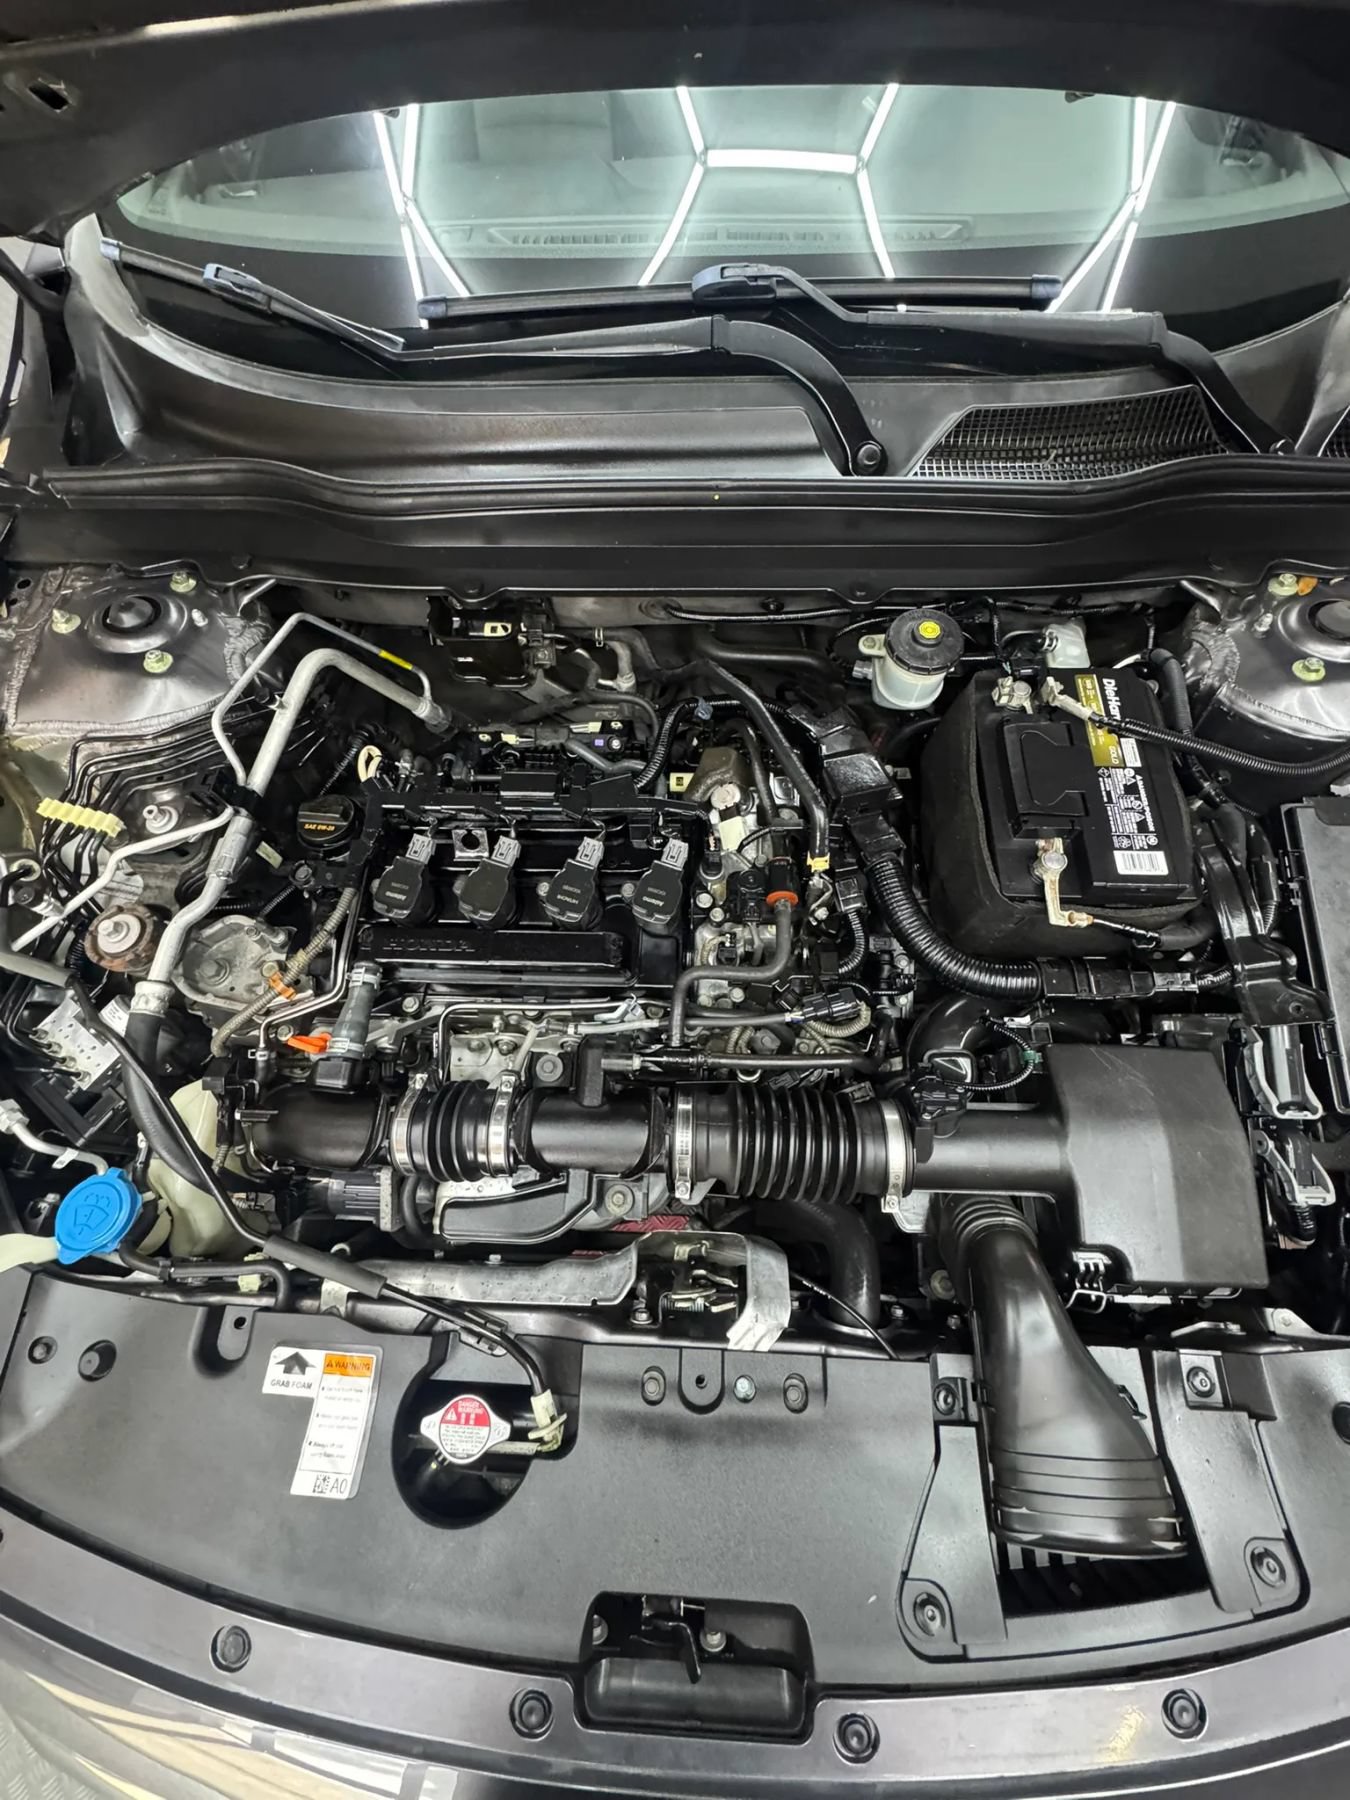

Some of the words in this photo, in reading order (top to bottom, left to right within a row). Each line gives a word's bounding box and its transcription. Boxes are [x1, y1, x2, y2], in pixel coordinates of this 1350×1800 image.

[1102, 678, 1121, 721] DieHar
[1108, 745, 1119, 765] GOLD
[382, 938, 476, 953] HONDA
[335, 1360, 371, 1371] WARNING
[270, 1379, 291, 1389] GRAB
[291, 1381, 313, 1390] FOAM
